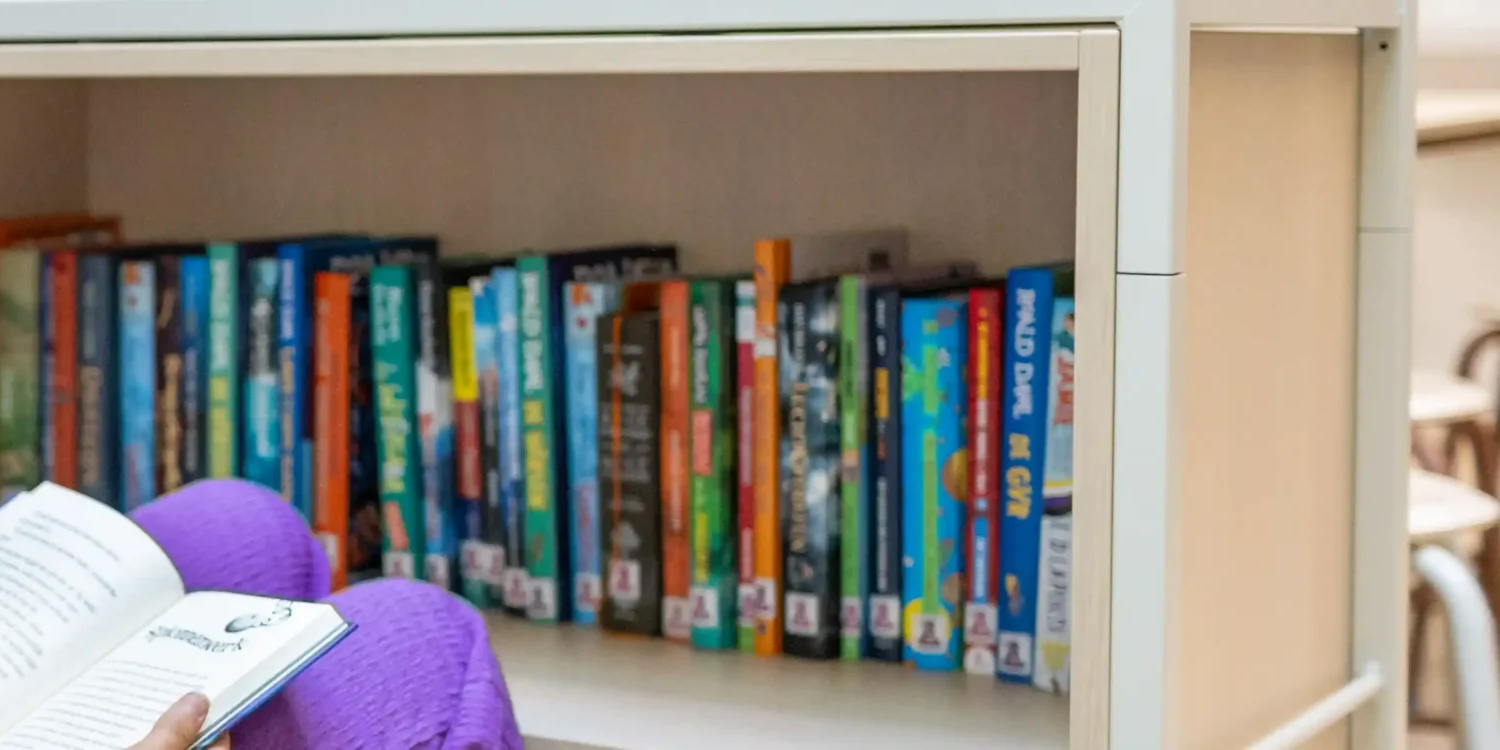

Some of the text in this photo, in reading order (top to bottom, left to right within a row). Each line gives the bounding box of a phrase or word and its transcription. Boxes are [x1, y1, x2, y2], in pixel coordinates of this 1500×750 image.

[1015, 289, 1036, 357] ROALD
[1013, 362, 1034, 419] DAHL
[1007, 467, 1032, 519] GVR
